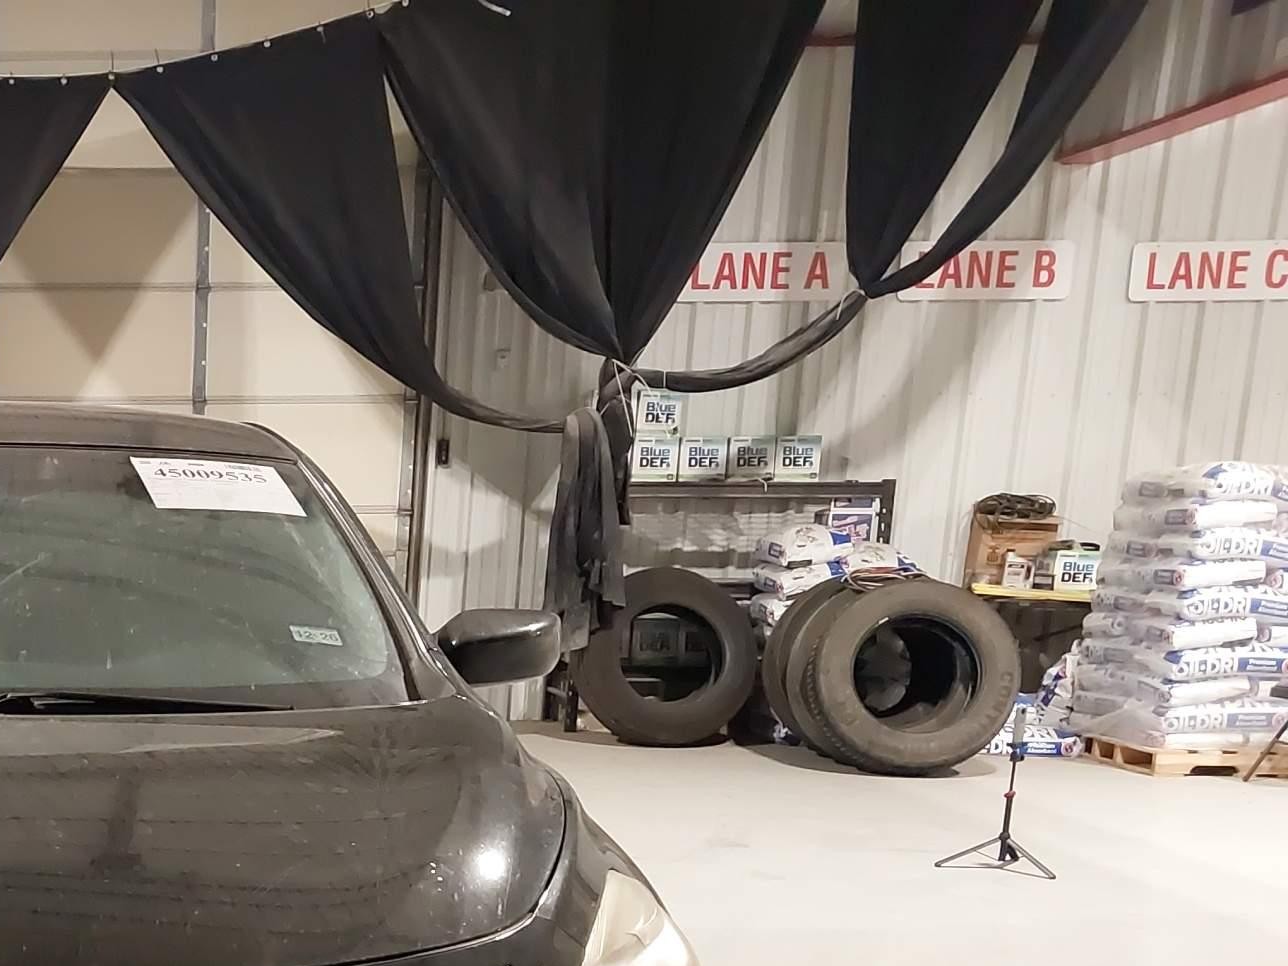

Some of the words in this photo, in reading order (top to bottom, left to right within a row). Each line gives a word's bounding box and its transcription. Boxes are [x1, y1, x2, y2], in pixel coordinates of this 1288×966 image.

[690, 251, 793, 290] LANE
[803, 251, 830, 290] A
[1031, 250, 1057, 288] B
[1146, 250, 1251, 290] LANE
[1264, 248, 1288, 289] C
[640, 446, 671, 457] Blue
[688, 446, 720, 457] Blue
[737, 446, 768, 457] Blue
[782, 445, 814, 456] Blue
[153, 467, 268, 484] 45009535
[1063, 561, 1095, 572] Blue
